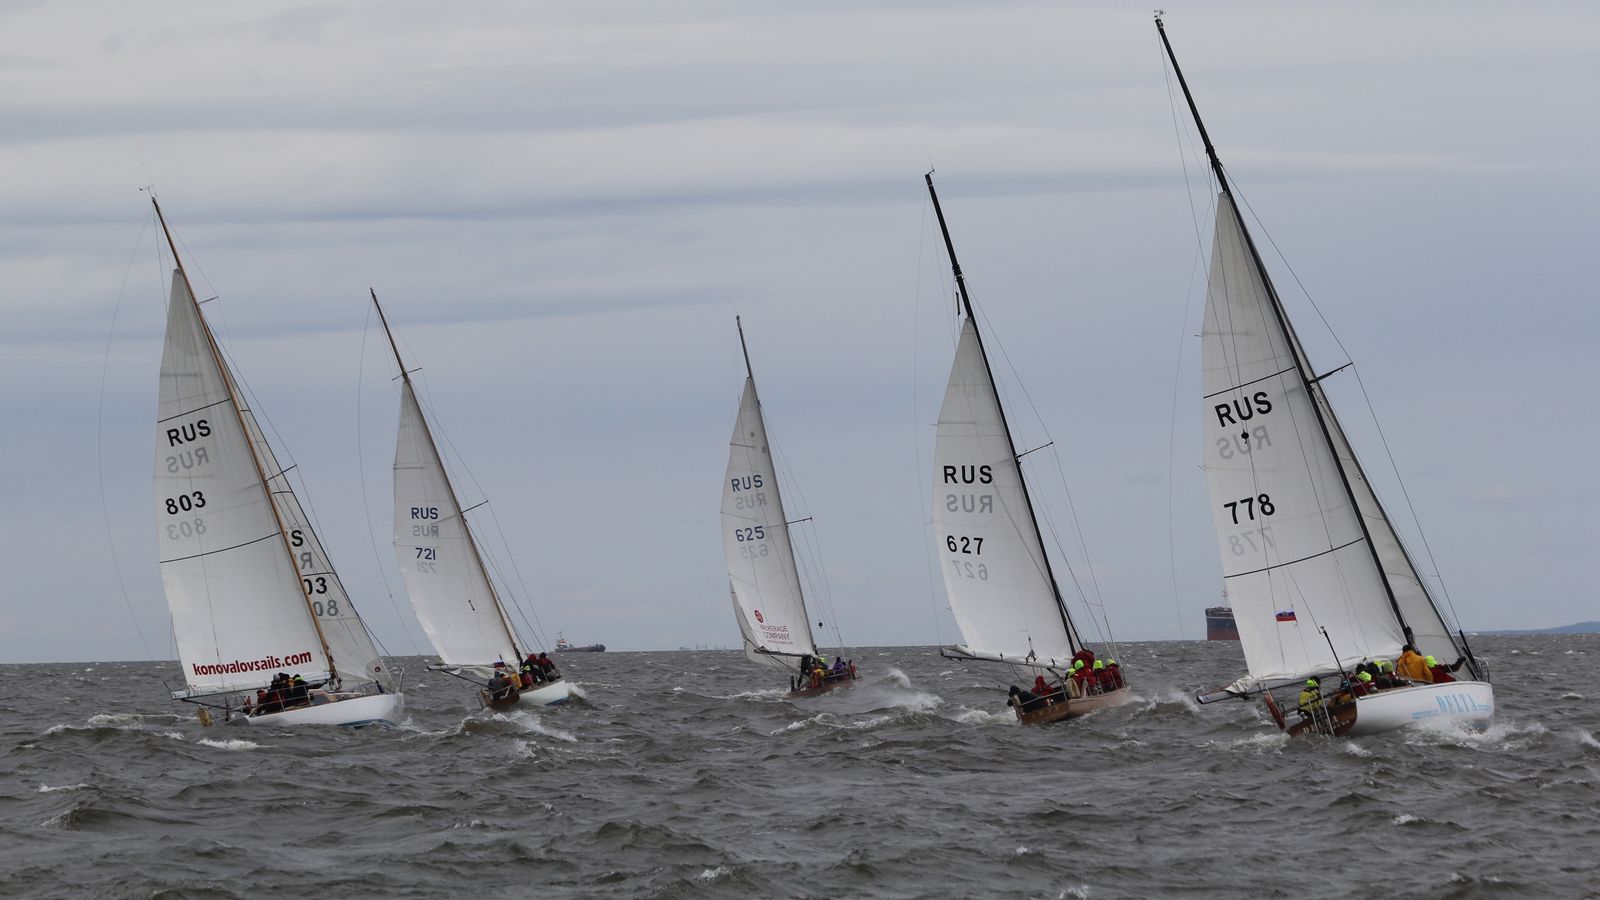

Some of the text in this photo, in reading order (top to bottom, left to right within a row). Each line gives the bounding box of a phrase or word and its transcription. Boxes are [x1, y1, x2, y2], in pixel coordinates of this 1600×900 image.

[1214, 391, 1273, 428] RUS
[166, 419, 211, 447] RUS
[731, 474, 763, 493] RUS
[943, 464, 993, 485] RUS
[165, 490, 206, 515] 803
[1223, 493, 1275, 525] 778
[411, 507, 439, 520] RUS
[735, 525, 765, 543] 625
[415, 547, 436, 560] 721
[946, 535, 984, 555] 627
[192, 651, 312, 676] konovalovsails.com
